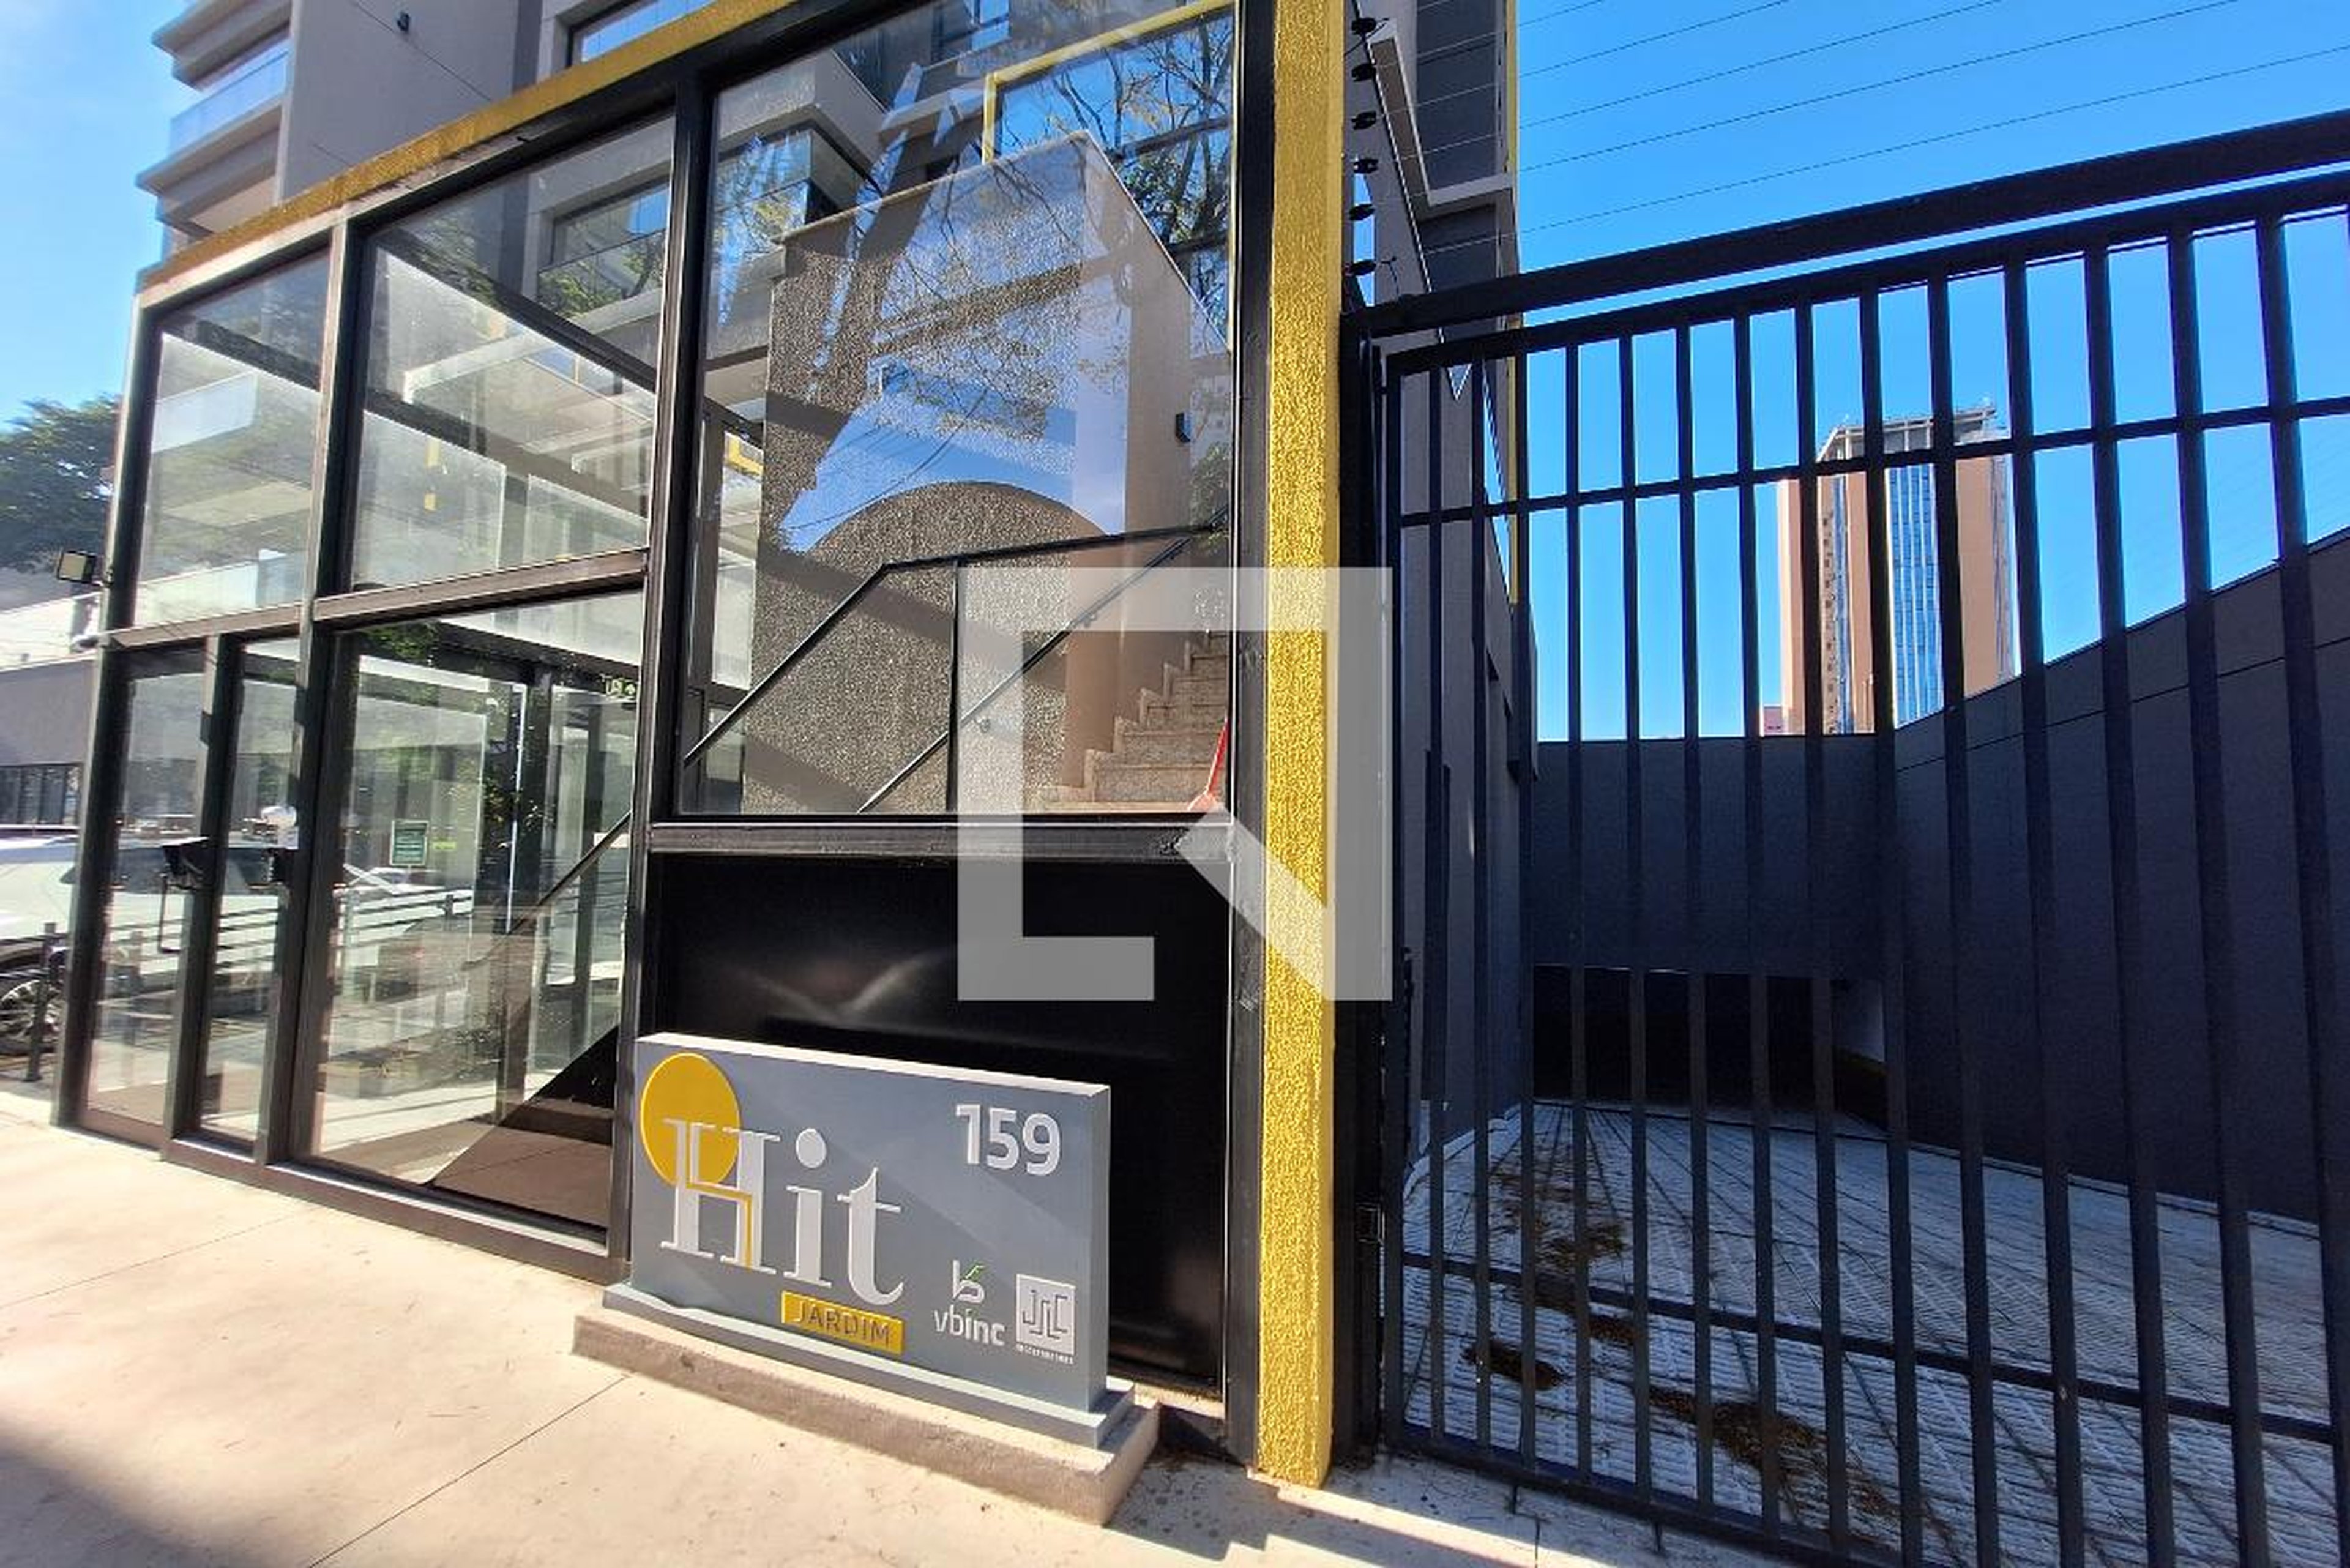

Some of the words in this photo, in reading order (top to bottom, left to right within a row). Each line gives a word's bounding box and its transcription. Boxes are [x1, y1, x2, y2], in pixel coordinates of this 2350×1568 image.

[956, 1104, 1061, 1176] 159
[660, 1118, 905, 1306] Hit
[792, 1300, 890, 1347] JARDIM
[934, 1304, 1007, 1346] vbinc
